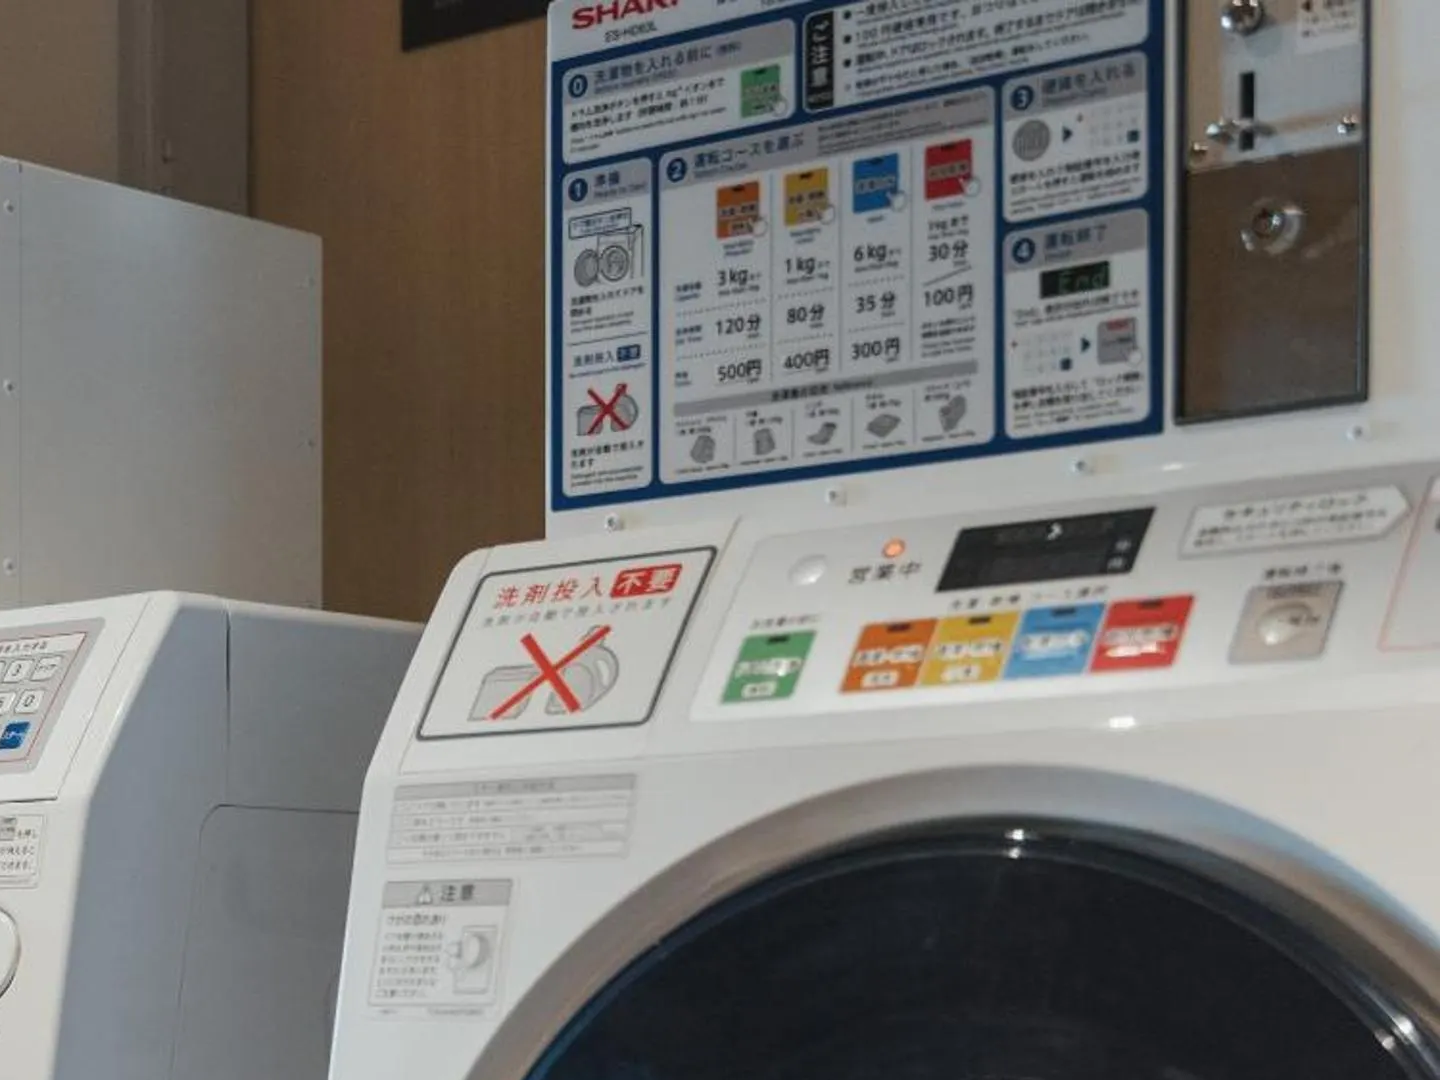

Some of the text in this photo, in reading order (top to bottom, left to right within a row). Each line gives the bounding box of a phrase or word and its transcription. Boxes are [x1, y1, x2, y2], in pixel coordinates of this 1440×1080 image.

[694, 133, 805, 168] 運転コースを選ぶ
[1045, 223, 1108, 250] 運転終了
[923, 283, 974, 307] 100円
[716, 314, 762, 336] 120分
[786, 303, 825, 324] 80分
[784, 347, 830, 370] 400円
[851, 336, 901, 361] 300円
[717, 358, 762, 383] 500円
[848, 561, 922, 585] 営業中
[494, 566, 678, 611] 洗剤投入 不要
[440, 883, 475, 902] 注意
